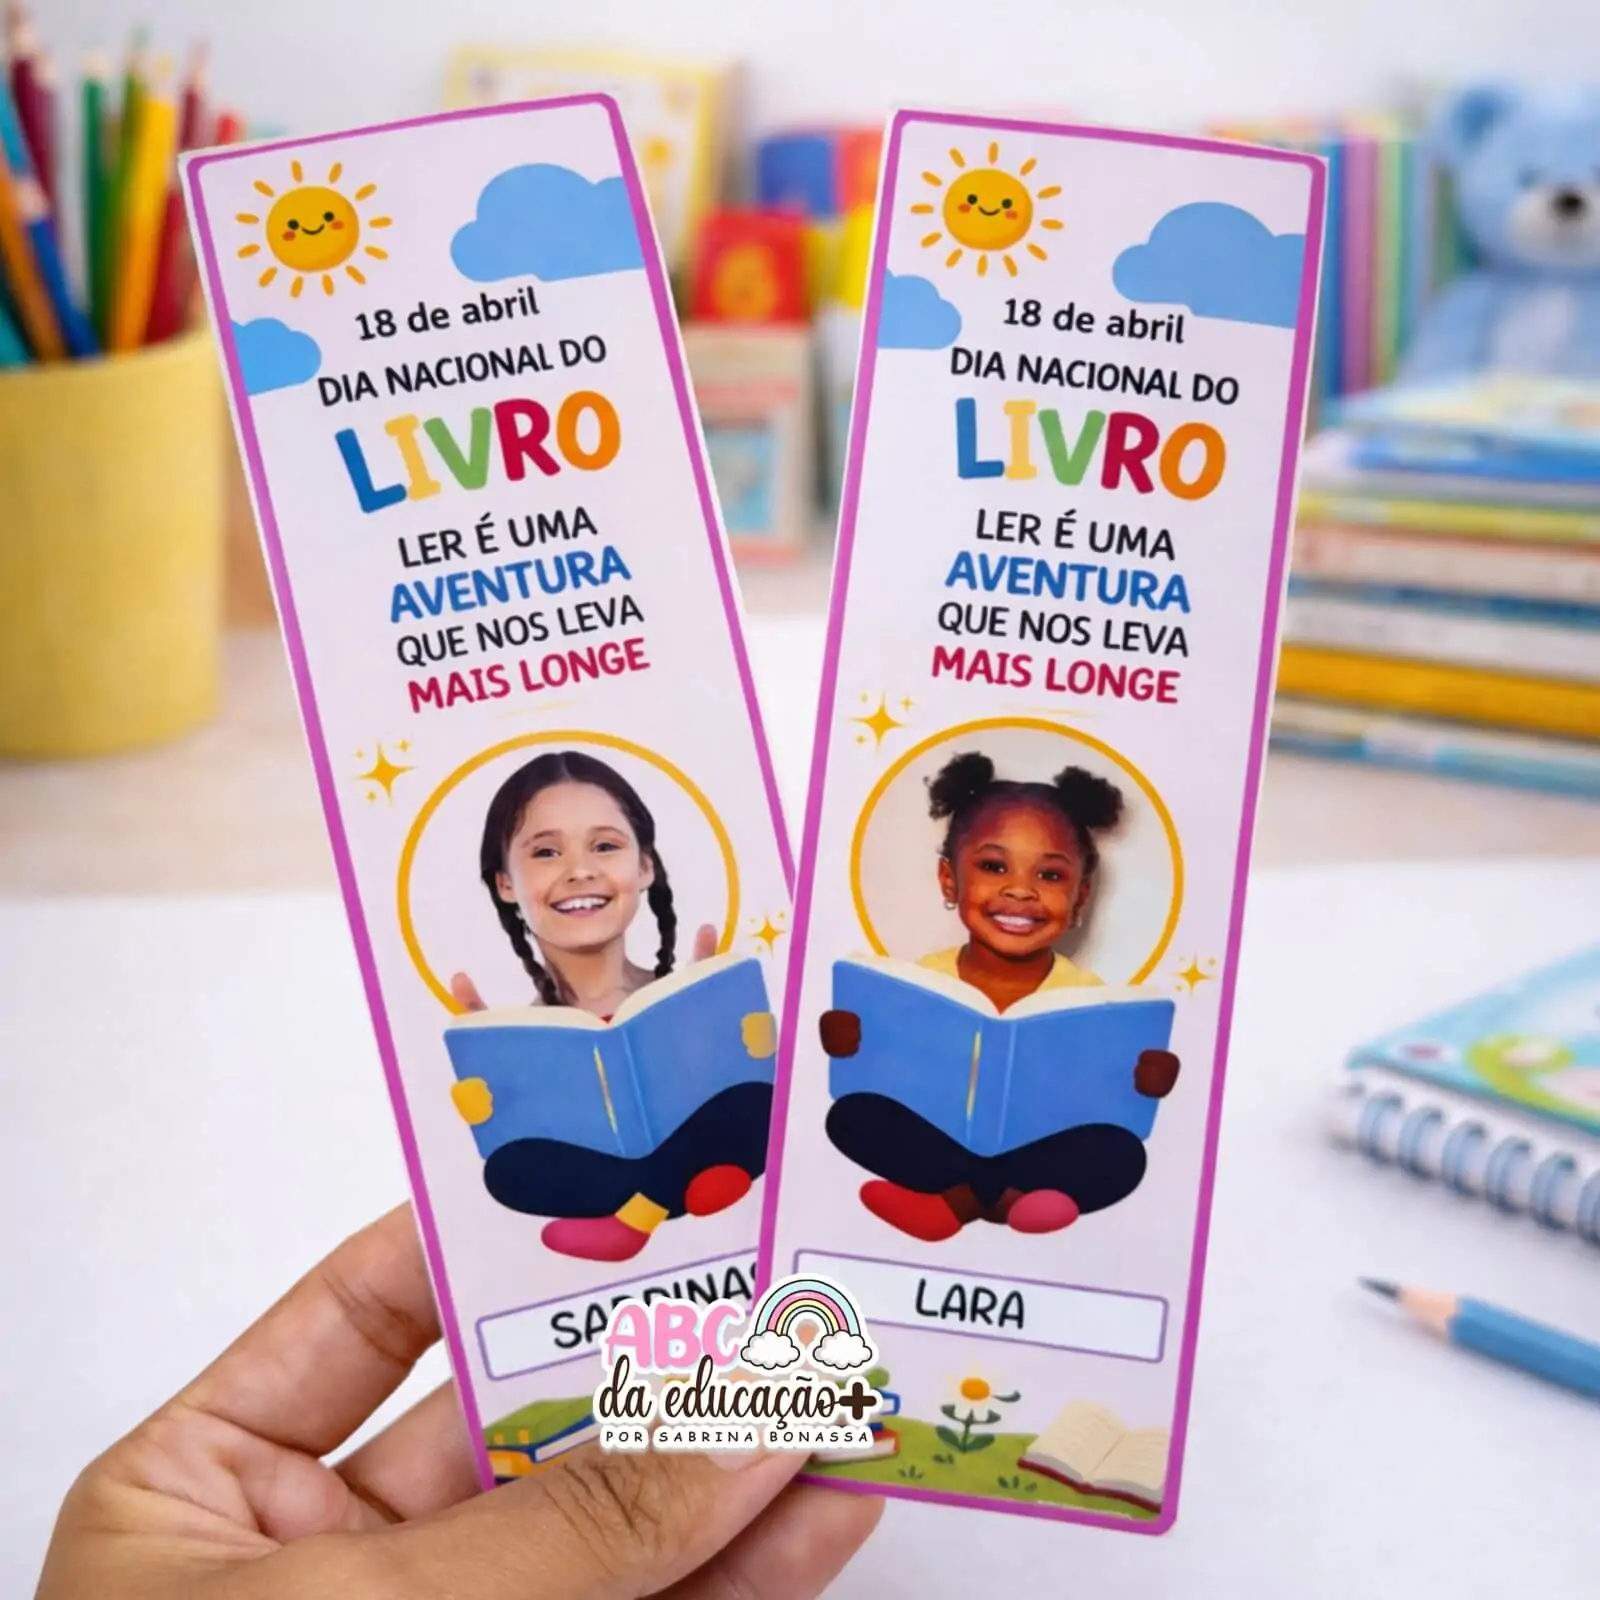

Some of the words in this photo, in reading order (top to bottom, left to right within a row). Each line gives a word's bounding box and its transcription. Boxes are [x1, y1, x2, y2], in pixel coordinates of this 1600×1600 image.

[355, 309, 397, 341] 18
[408, 301, 450, 334] de
[462, 286, 540, 324] abril
[1003, 299, 1042, 327] 18
[1053, 302, 1095, 333] de
[1106, 310, 1185, 343] abril
[318, 371, 378, 406] DIA
[385, 343, 554, 394] NACIONAL
[560, 335, 607, 368] DO
[951, 347, 1005, 380] DIA
[1017, 354, 1182, 399] NACIONAL
[1192, 373, 1239, 405] DO
[335, 390, 621, 513] LIVRO
[956, 397, 1226, 500] LIVRO
[398, 529, 466, 567] LER
[475, 512, 499, 554] É
[509, 506, 598, 548] UMA
[976, 509, 1041, 546] LER
[1054, 509, 1077, 549] É
[1089, 522, 1175, 560] UMA
[390, 546, 632, 623] AVENTURA
[945, 551, 1190, 613] AVENTURA
[396, 626, 468, 666] QUE
[477, 612, 549, 652] NOS
[558, 595, 644, 636] LEVA
[938, 602, 1009, 637] QUE
[1019, 610, 1091, 646] NOS
[1103, 620, 1189, 657] LEVA
[408, 664, 510, 713] MAIS
[519, 638, 650, 691] LONGE
[932, 645, 1033, 688] MAIS
[1045, 658, 1180, 703] LONGE
[915, 1278, 1024, 1330] LARA
